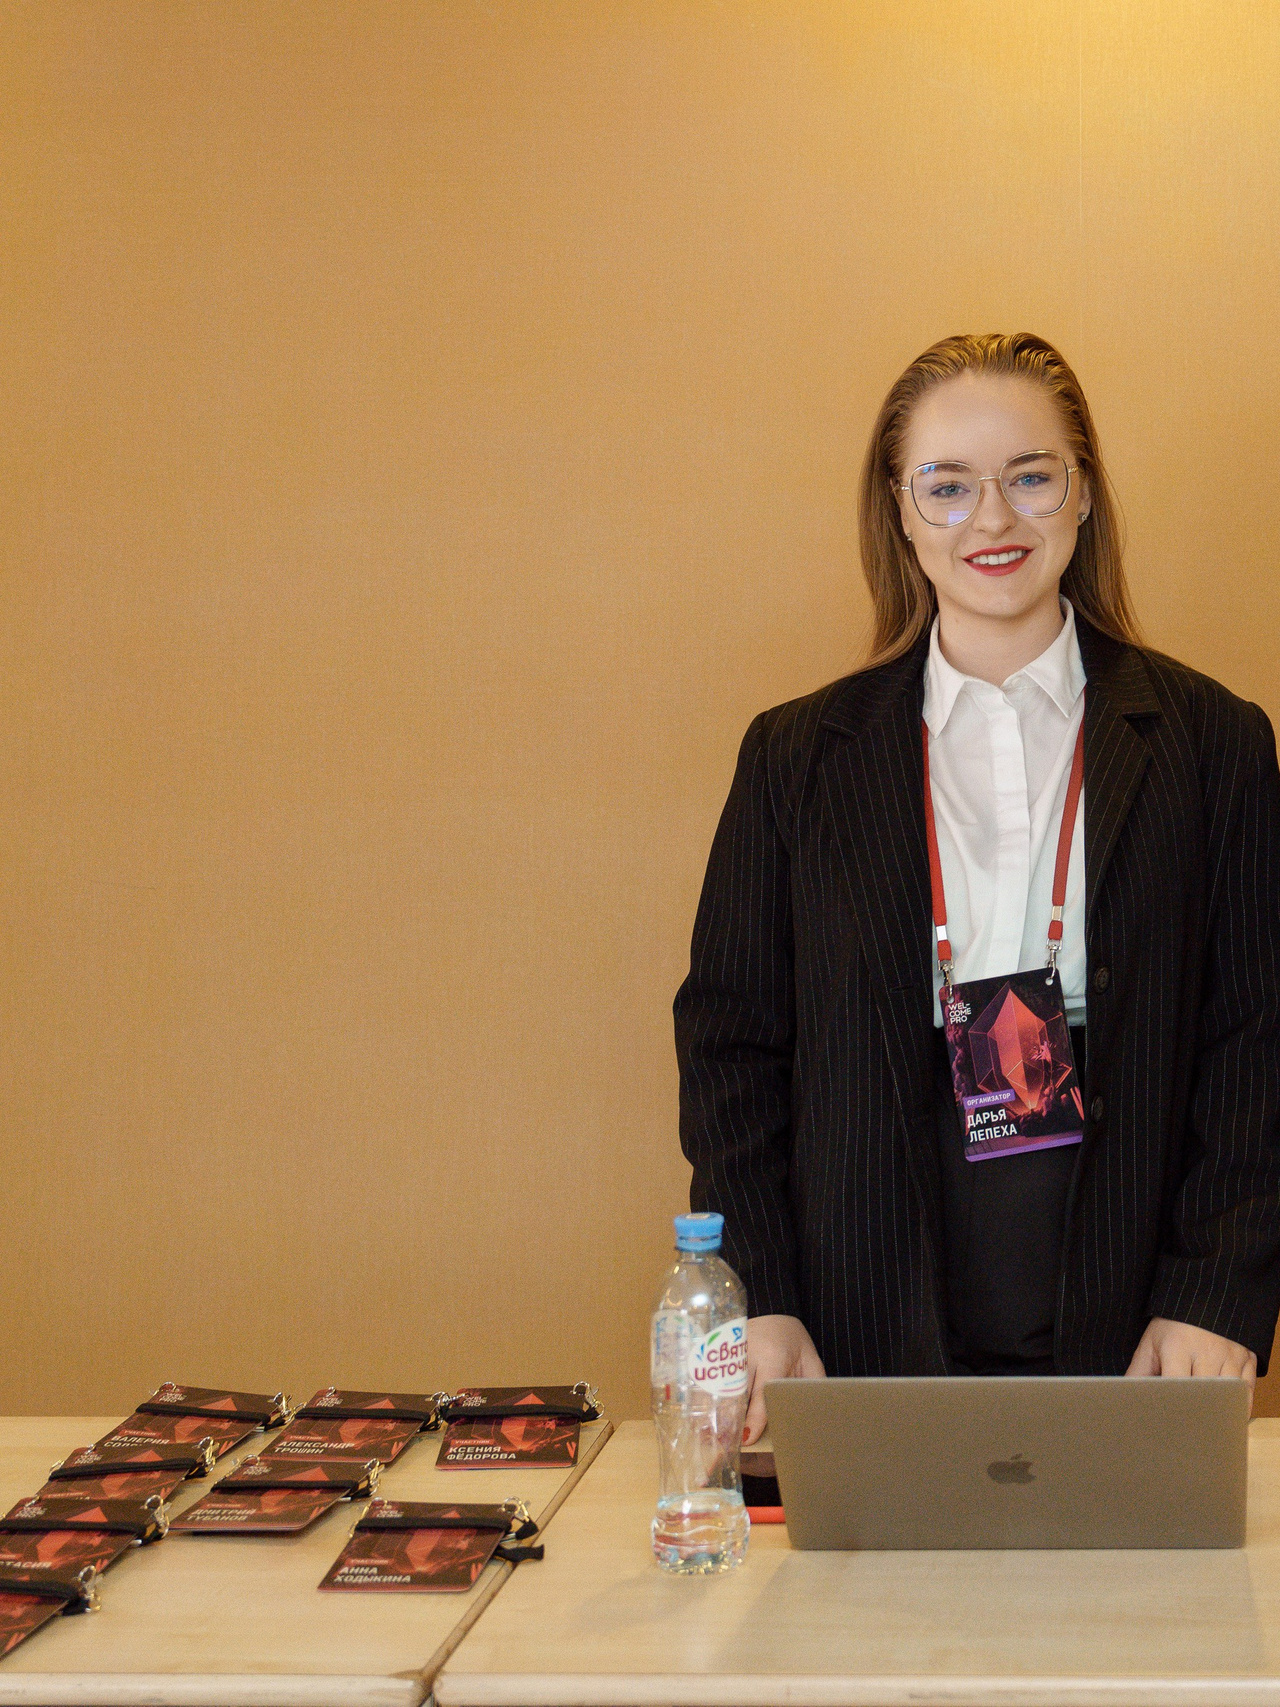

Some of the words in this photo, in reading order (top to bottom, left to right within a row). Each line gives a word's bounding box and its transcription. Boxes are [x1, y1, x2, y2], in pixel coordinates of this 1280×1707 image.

[949, 1002, 971, 1011] WEL-
[949, 1008, 972, 1018] COME
[950, 1015, 968, 1024] PRO
[967, 1092, 1011, 1106] ОРГАНИЗАТОР
[967, 1109, 1007, 1128] ДАРЬЯ
[969, 1123, 1018, 1143] ЛЕПЕХА
[111, 1435, 170, 1445] ВАЛЕРИЯ
[278, 1441, 355, 1449] АЛЕКСАНДР
[338, 1566, 378, 1575] АННА
[333, 1575, 411, 1584] ХОДЫКИНА
